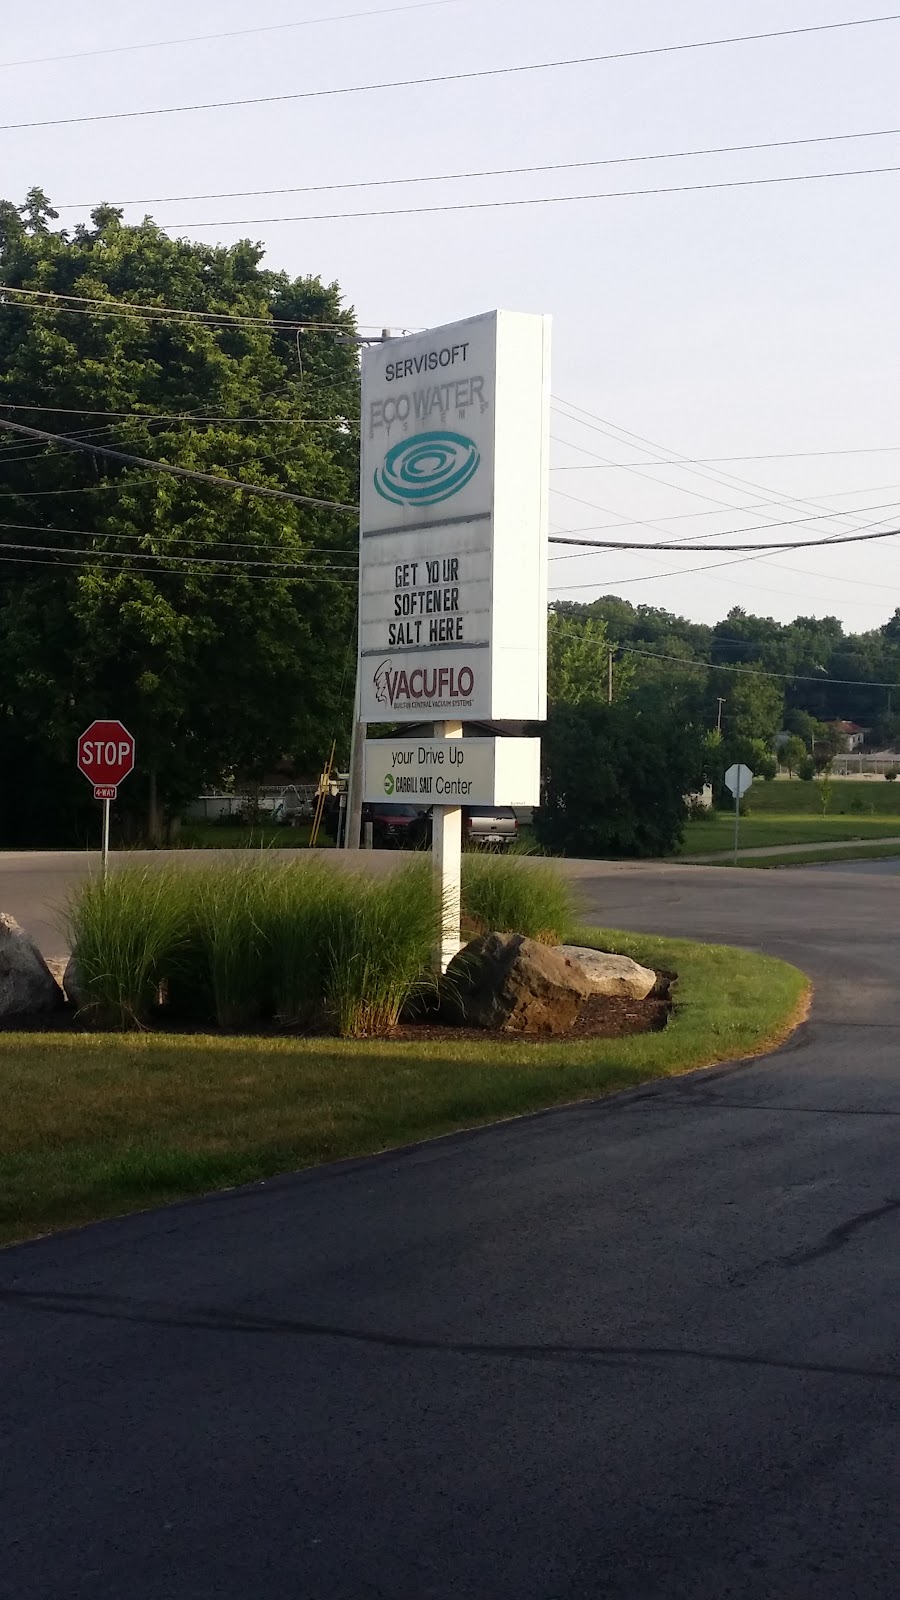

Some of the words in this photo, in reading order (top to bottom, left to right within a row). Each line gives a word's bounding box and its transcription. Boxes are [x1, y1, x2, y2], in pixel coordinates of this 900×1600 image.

[385, 343, 469, 381] SERVISOFT
[370, 376, 485, 429] ECOWATER
[395, 563, 418, 588] GET
[426, 558, 459, 583] YOUR
[394, 588, 459, 616] SOFTENER
[388, 620, 422, 645] SALT
[429, 617, 463, 642] HERE
[385, 666, 475, 707] VACUFLO
[451, 700, 472, 708] SYSTEMS
[82, 741, 130, 765] STOP
[392, 750, 414, 767] your
[418, 747, 444, 765] Drive
[449, 747, 464, 767] Up
[96, 789, 115, 797] 4-WAY
[395, 776, 418, 793] CARGILL
[419, 776, 433, 793] SALT
[435, 776, 473, 794] Center
